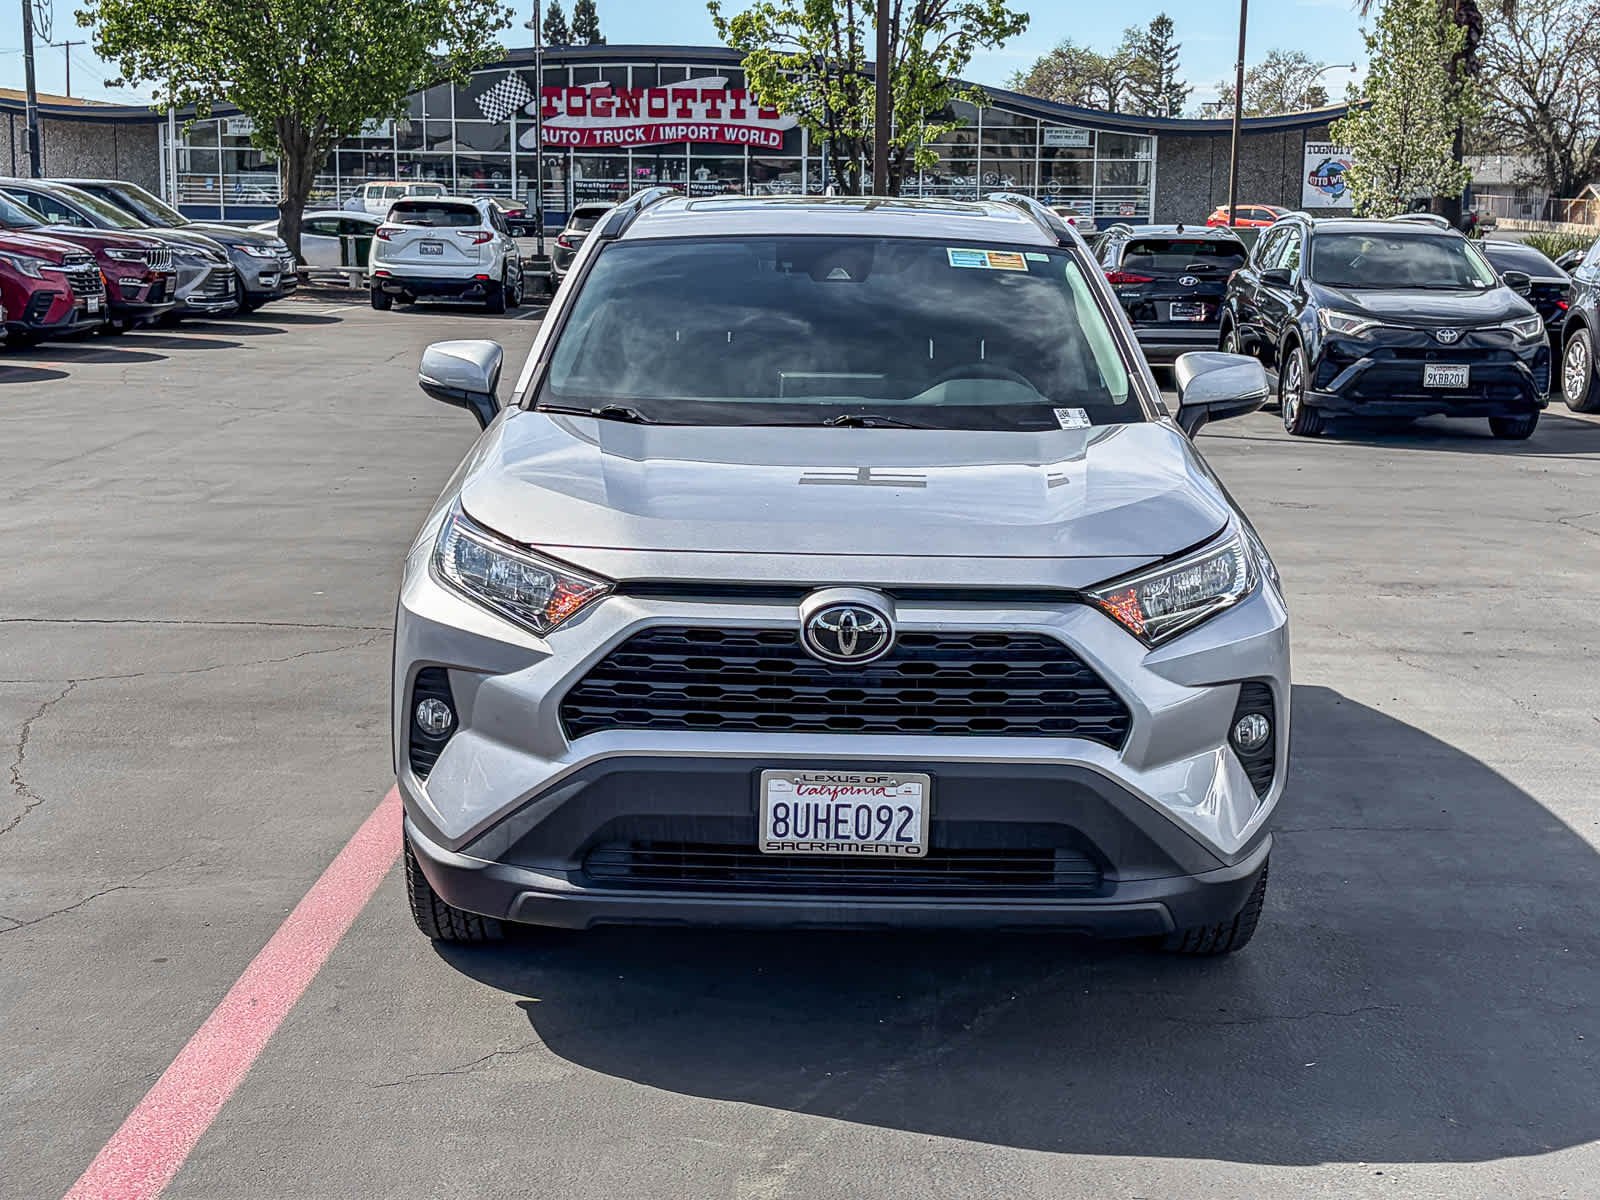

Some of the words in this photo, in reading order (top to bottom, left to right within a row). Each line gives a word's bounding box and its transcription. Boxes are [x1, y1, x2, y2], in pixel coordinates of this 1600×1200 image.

[541, 128, 581, 144] AUTO
[593, 127, 647, 144] TRUCK
[659, 125, 720, 141] IMPORT
[724, 127, 780, 147] WORLD
[802, 774, 861, 783] LEXUS
[864, 776, 889, 784] OF
[796, 784, 897, 801] California
[772, 802, 914, 842] 8UHE092
[766, 842, 921, 855] SACRAMENTO
